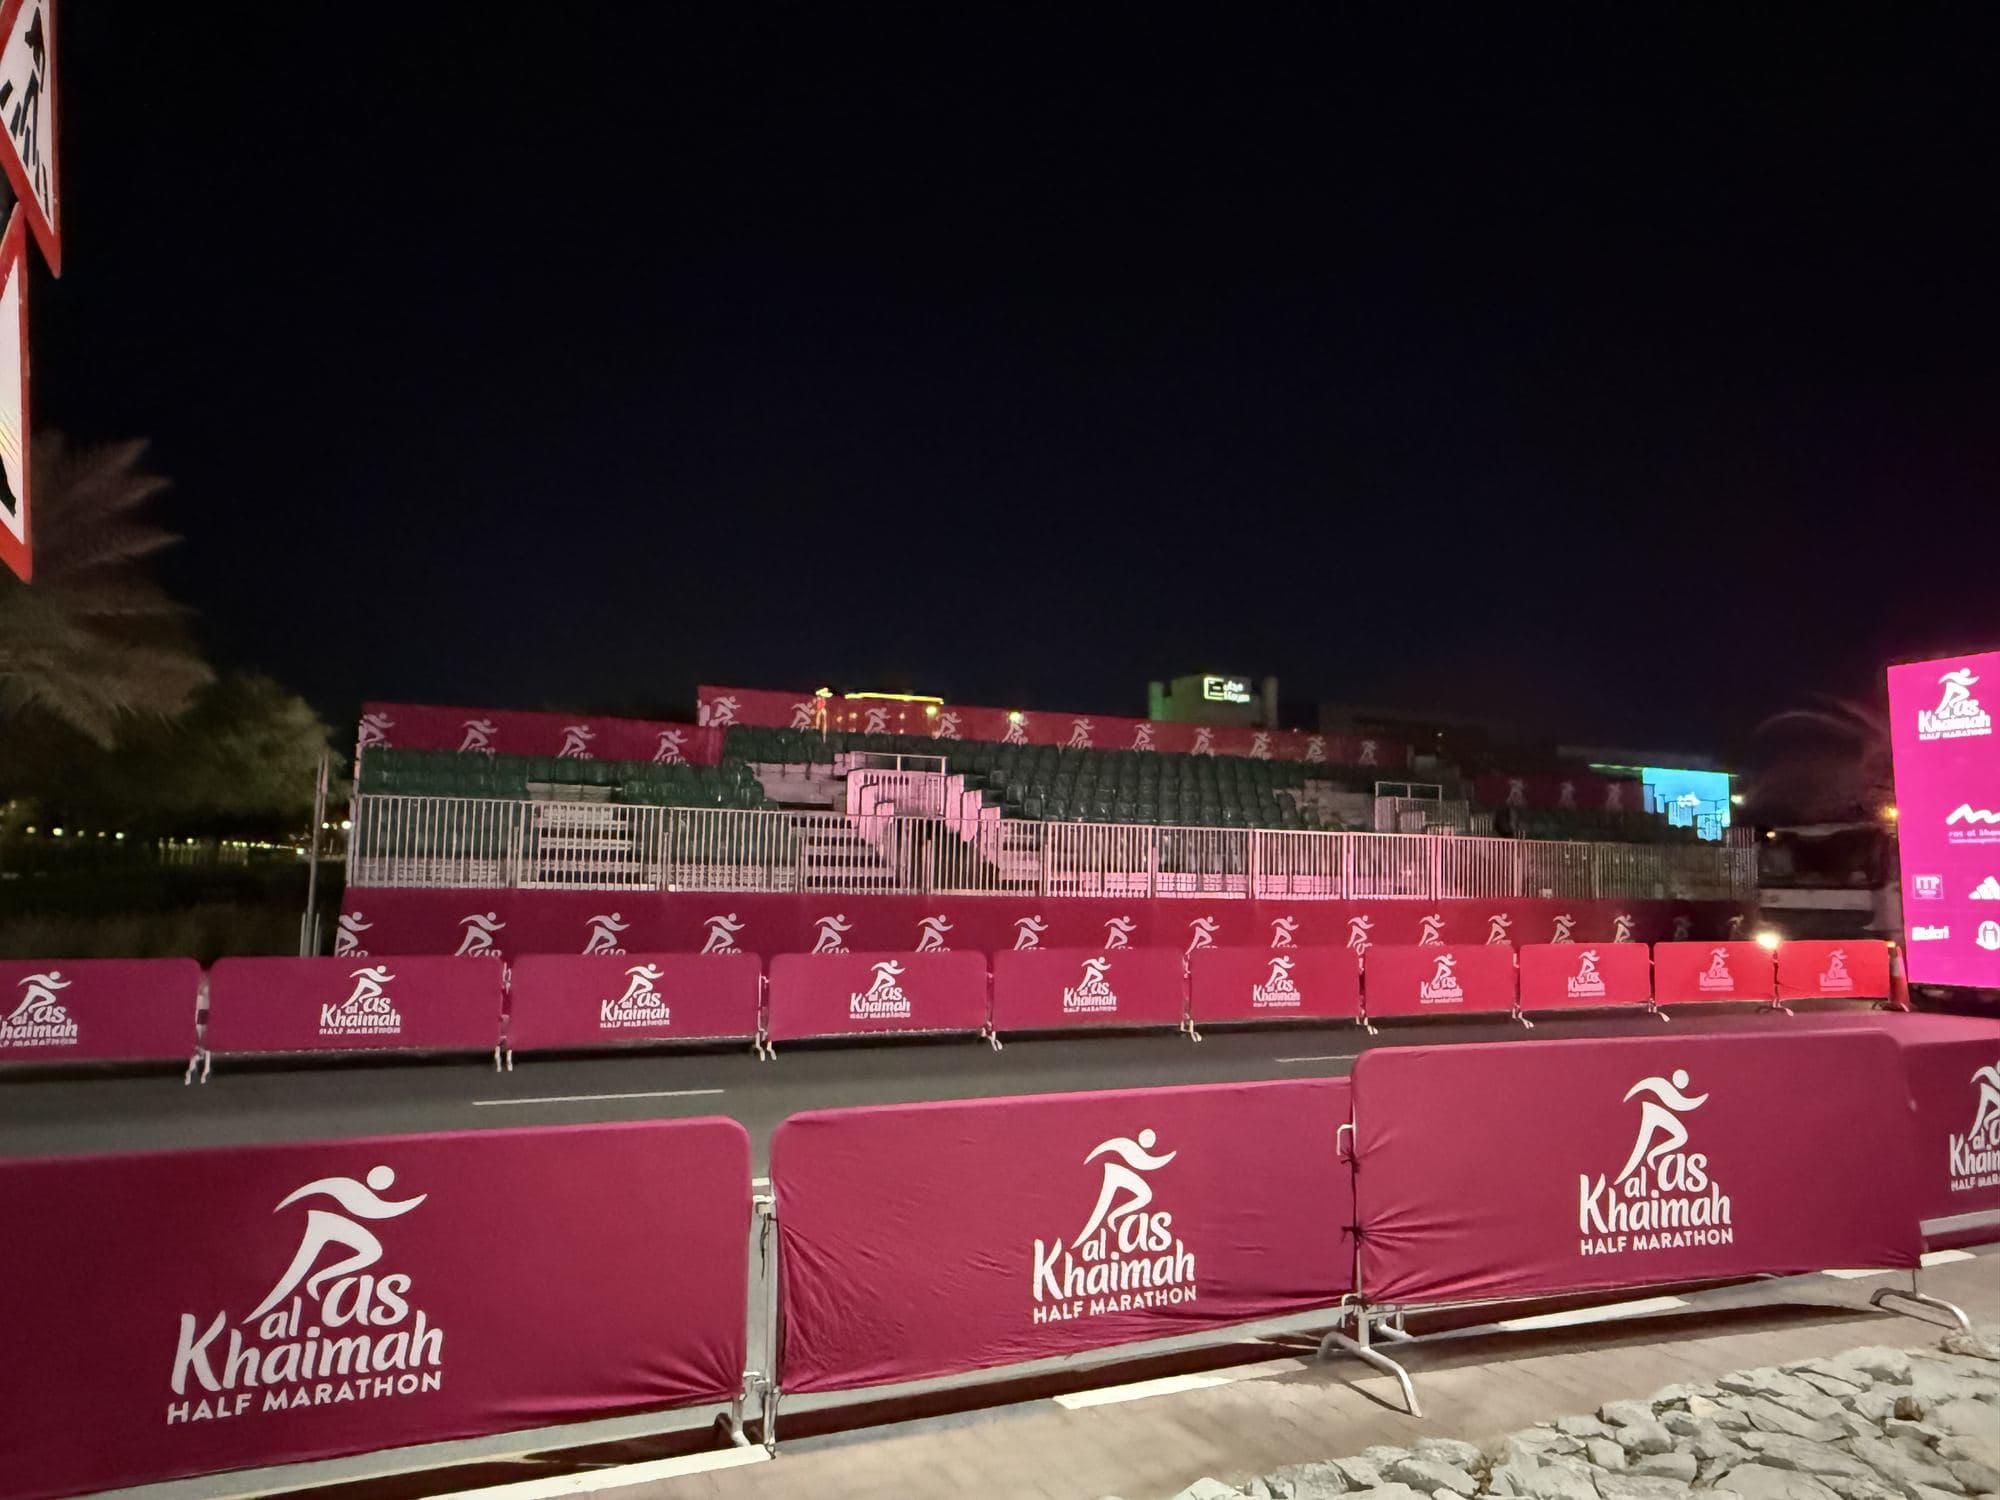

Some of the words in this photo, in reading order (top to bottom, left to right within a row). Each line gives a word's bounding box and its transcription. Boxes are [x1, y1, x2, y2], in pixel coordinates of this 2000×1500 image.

[0, 1015, 78, 1039] haimah
[320, 1003, 401, 1027] Khaimah
[600, 999, 670, 1021] Khaimah
[1624, 1166, 1647, 1198] al
[1579, 1173, 1732, 1235] Khaimah
[1082, 1227, 1107, 1261] al
[1580, 1236, 1628, 1256] HALF
[1633, 1228, 1733, 1251] MARATHON
[1033, 1237, 1195, 1302] Khaimah
[260, 1296, 302, 1340] al
[1033, 1301, 1084, 1324] HALF
[1089, 1285, 1197, 1316] MARATHON
[171, 1309, 443, 1395] Khaimah
[167, 1393, 252, 1425] HALF
[262, 1371, 442, 1412] MARATHON
